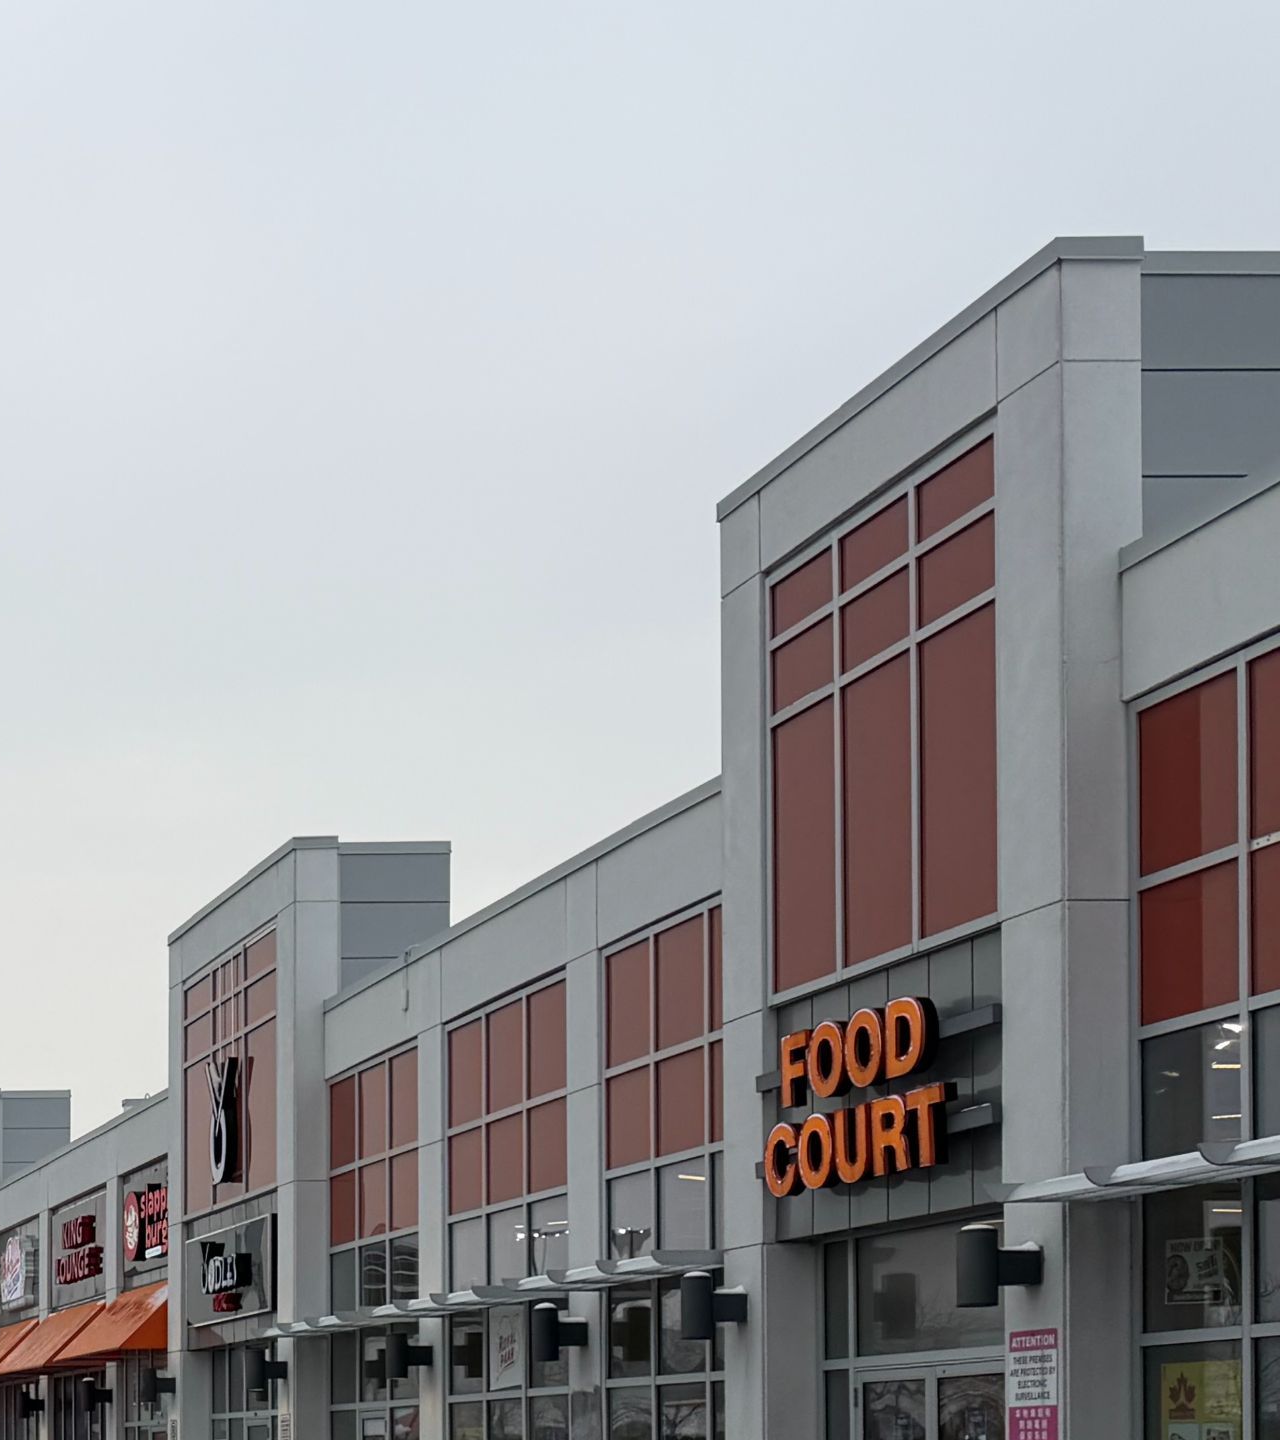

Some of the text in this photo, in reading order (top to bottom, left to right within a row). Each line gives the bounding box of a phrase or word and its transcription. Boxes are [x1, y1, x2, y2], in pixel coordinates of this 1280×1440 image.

[781, 997, 924, 1109] FOOD
[764, 1082, 946, 1198] COURT
[140, 1184, 168, 1221] slapp
[61, 1217, 84, 1249] KING
[145, 1219, 168, 1254] burg
[56, 1248, 90, 1284] LOUNGE
[1011, 1334, 1056, 1348] ATTENTION
[1010, 1366, 1056, 1377] ARE PROTECTED BY
[1013, 1354, 1053, 1365] THESE PREMISES
